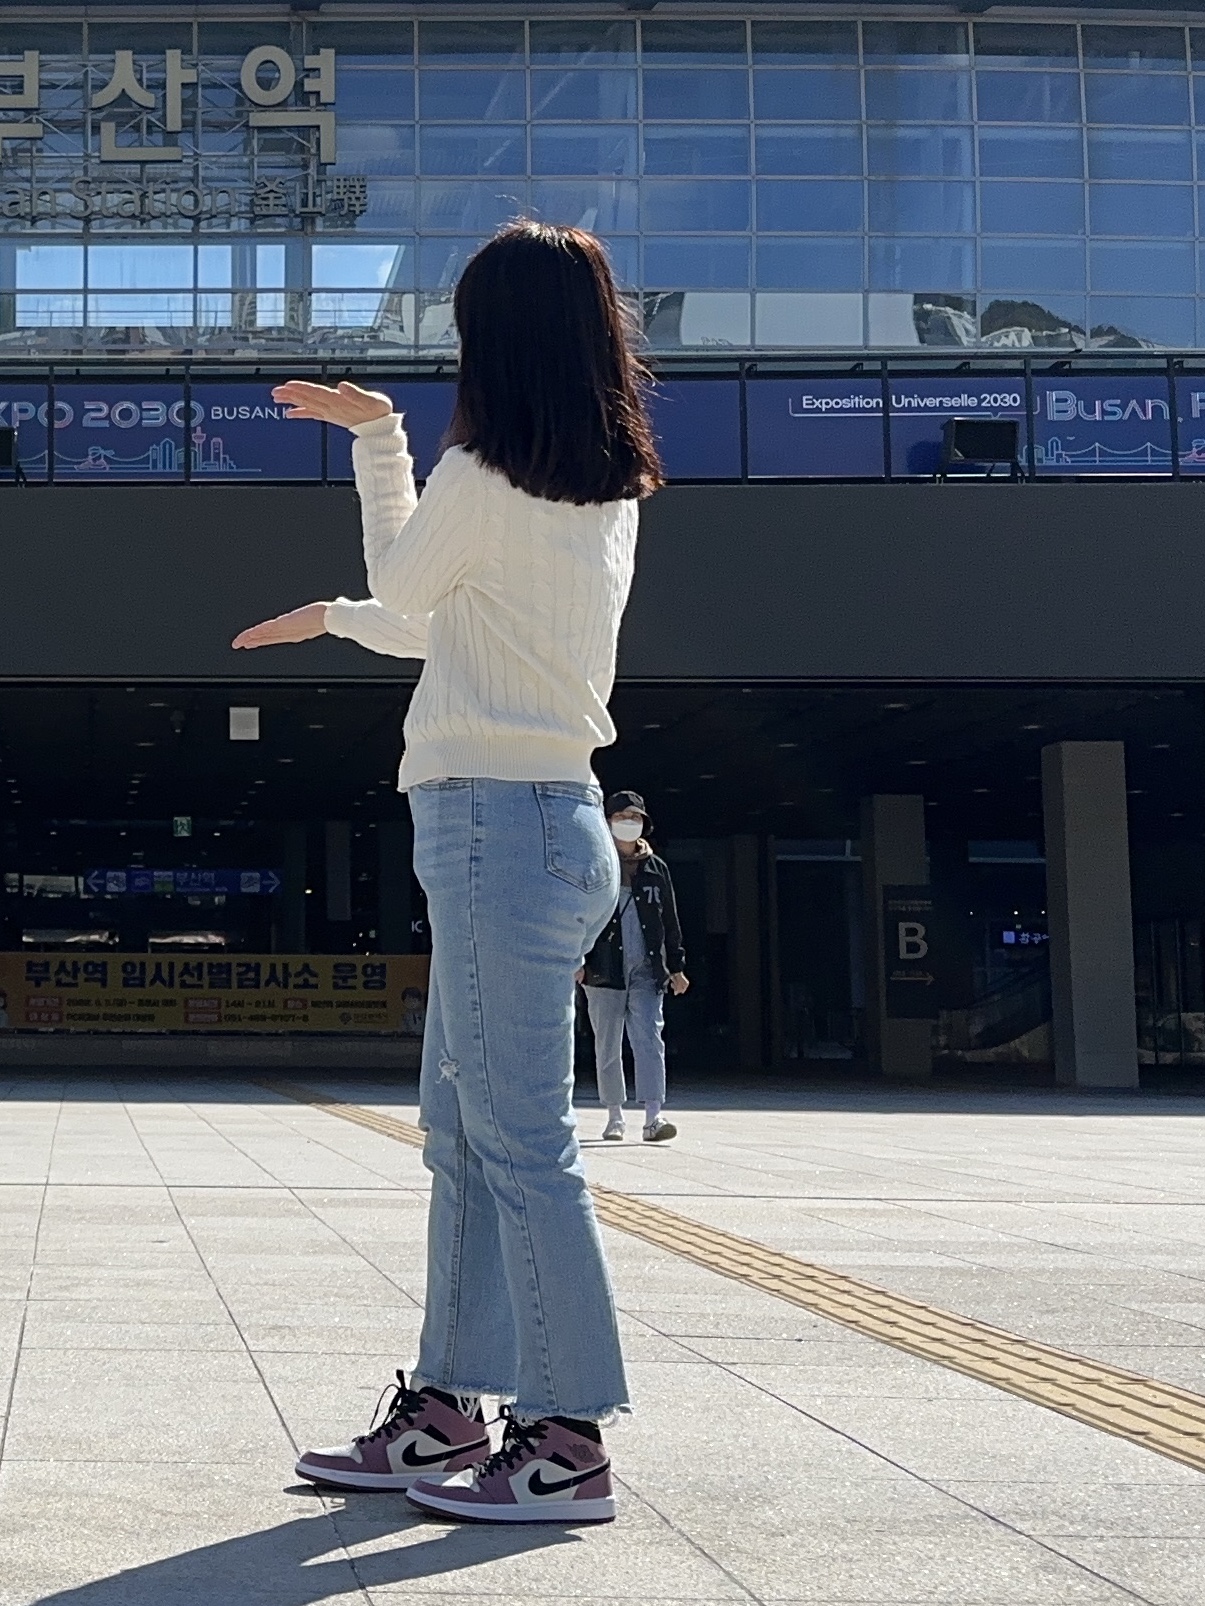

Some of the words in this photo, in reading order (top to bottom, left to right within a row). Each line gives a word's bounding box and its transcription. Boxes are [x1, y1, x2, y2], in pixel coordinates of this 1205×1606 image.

[0, 45, 336, 164] 부산역
[70, 177, 236, 218] Station
[82, 401, 205, 428] 2030
[802, 395, 882, 412] Exposition
[891, 394, 977, 409] Universelle
[980, 393, 1020, 408] 2030
[898, 921, 928, 959] B
[25, 960, 109, 988] 부산역
[121, 961, 319, 990] 임시선별검사소
[331, 962, 387, 990] 운영
